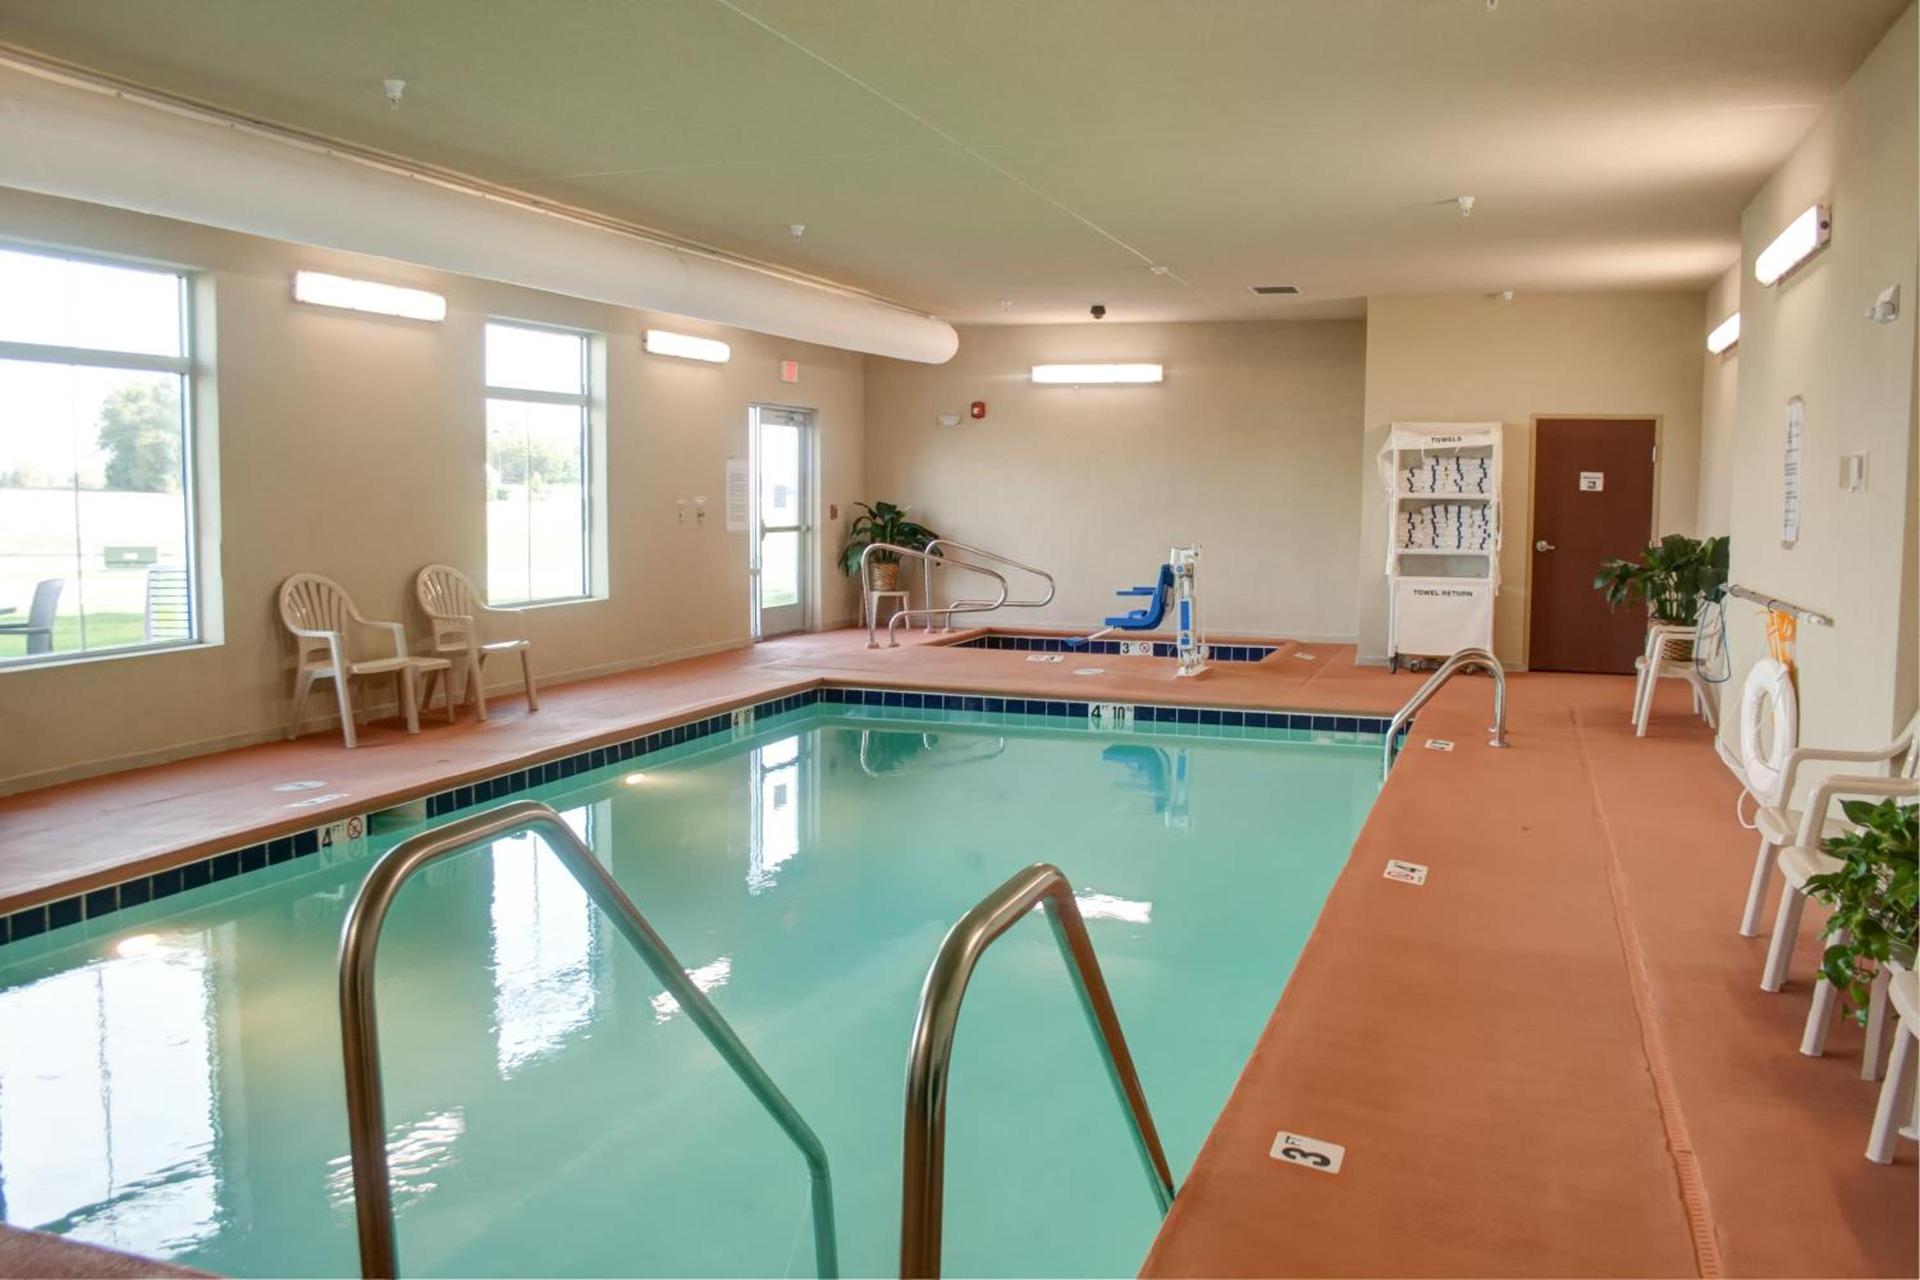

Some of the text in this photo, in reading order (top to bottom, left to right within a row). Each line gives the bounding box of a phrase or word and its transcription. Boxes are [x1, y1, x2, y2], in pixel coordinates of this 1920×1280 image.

[1413, 589, 1473, 598] TOWEL RETURN
[1122, 642, 1130, 654] 3
[1091, 704, 1102, 718] 4
[1113, 705, 1125, 720] 10
[322, 827, 333, 848] 4
[1282, 1147, 1331, 1167] 3
